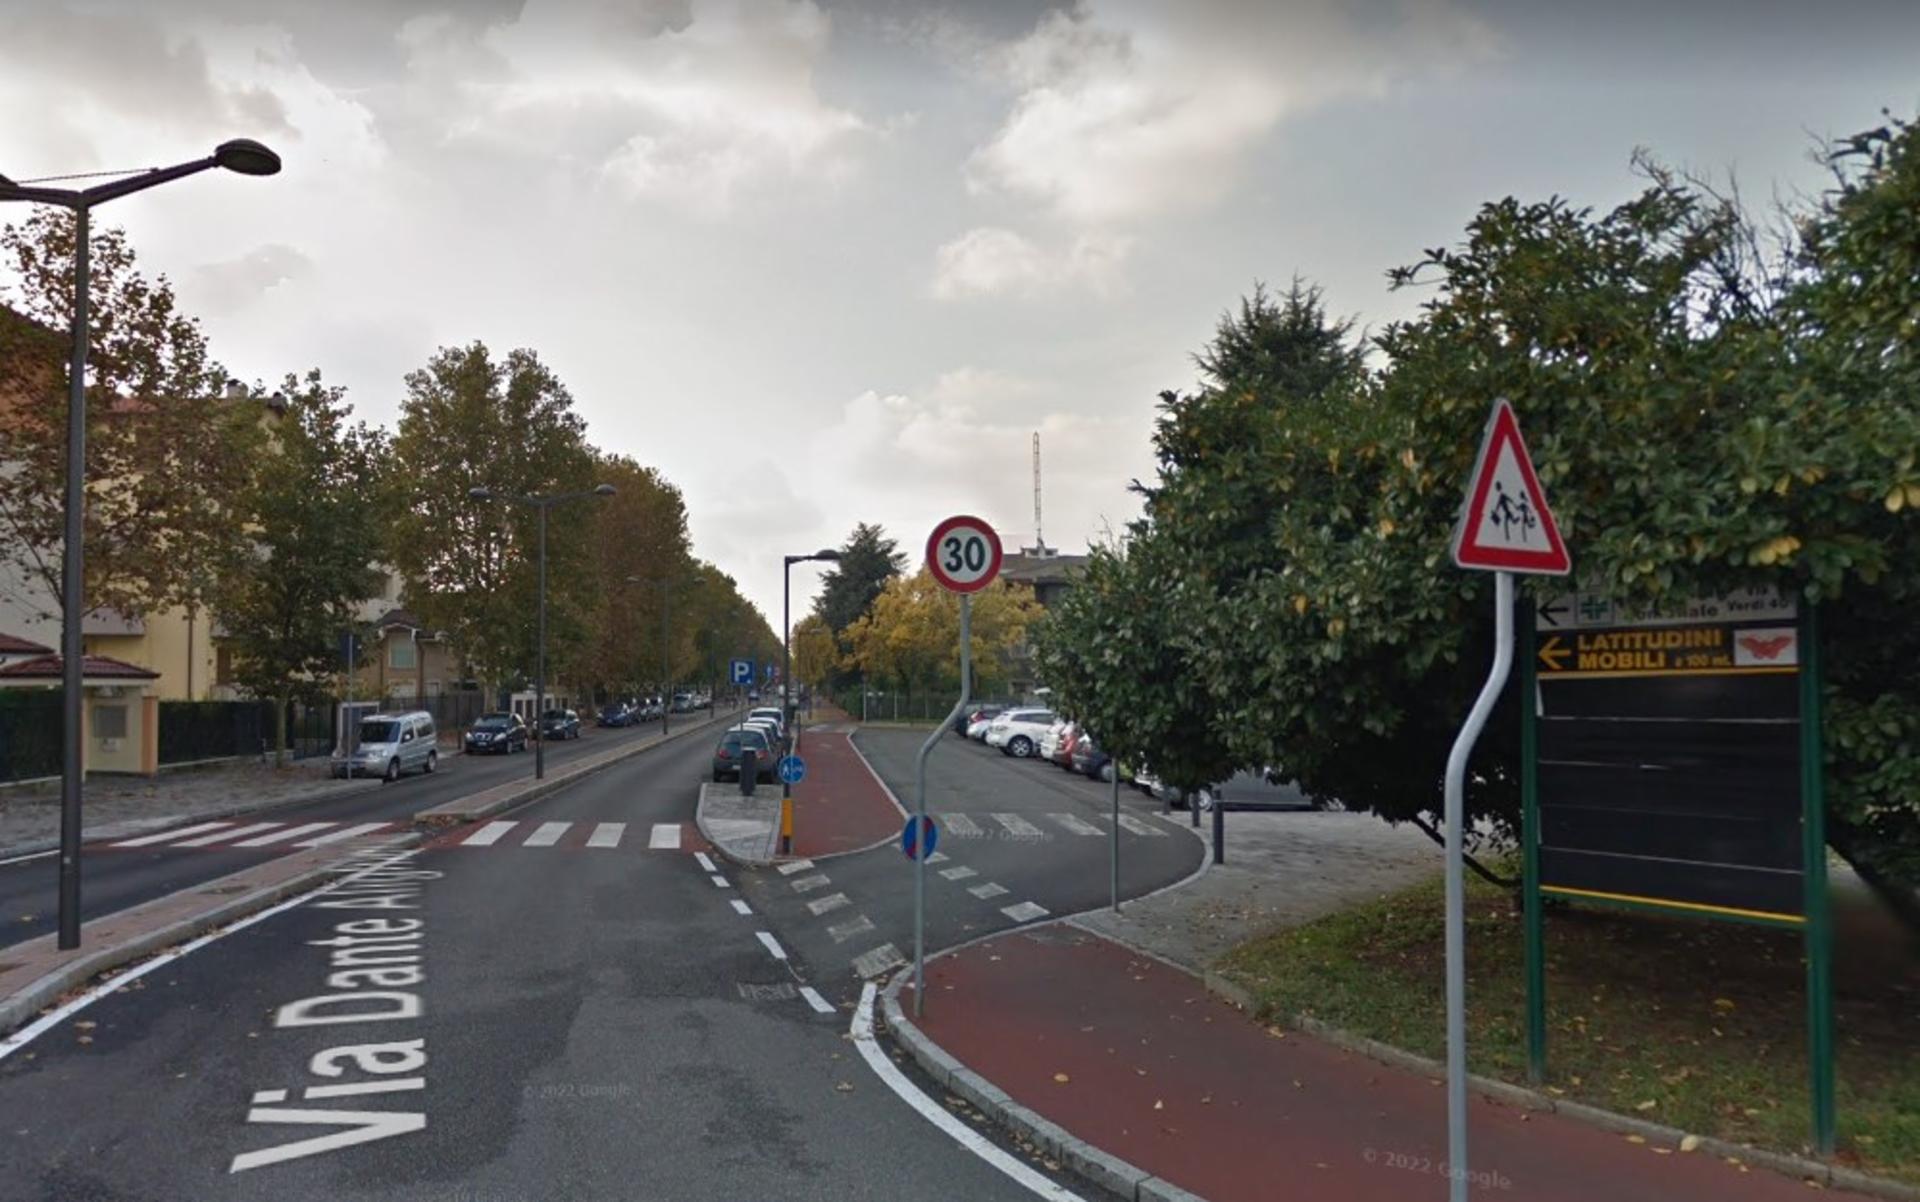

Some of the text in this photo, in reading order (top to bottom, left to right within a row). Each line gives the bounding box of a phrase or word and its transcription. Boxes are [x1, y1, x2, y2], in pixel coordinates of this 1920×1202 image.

[943, 536, 986, 573] 30
[1577, 629, 1722, 651] LATITUDINI
[1578, 651, 1665, 670] MOBILI
[733, 661, 749, 682] P
